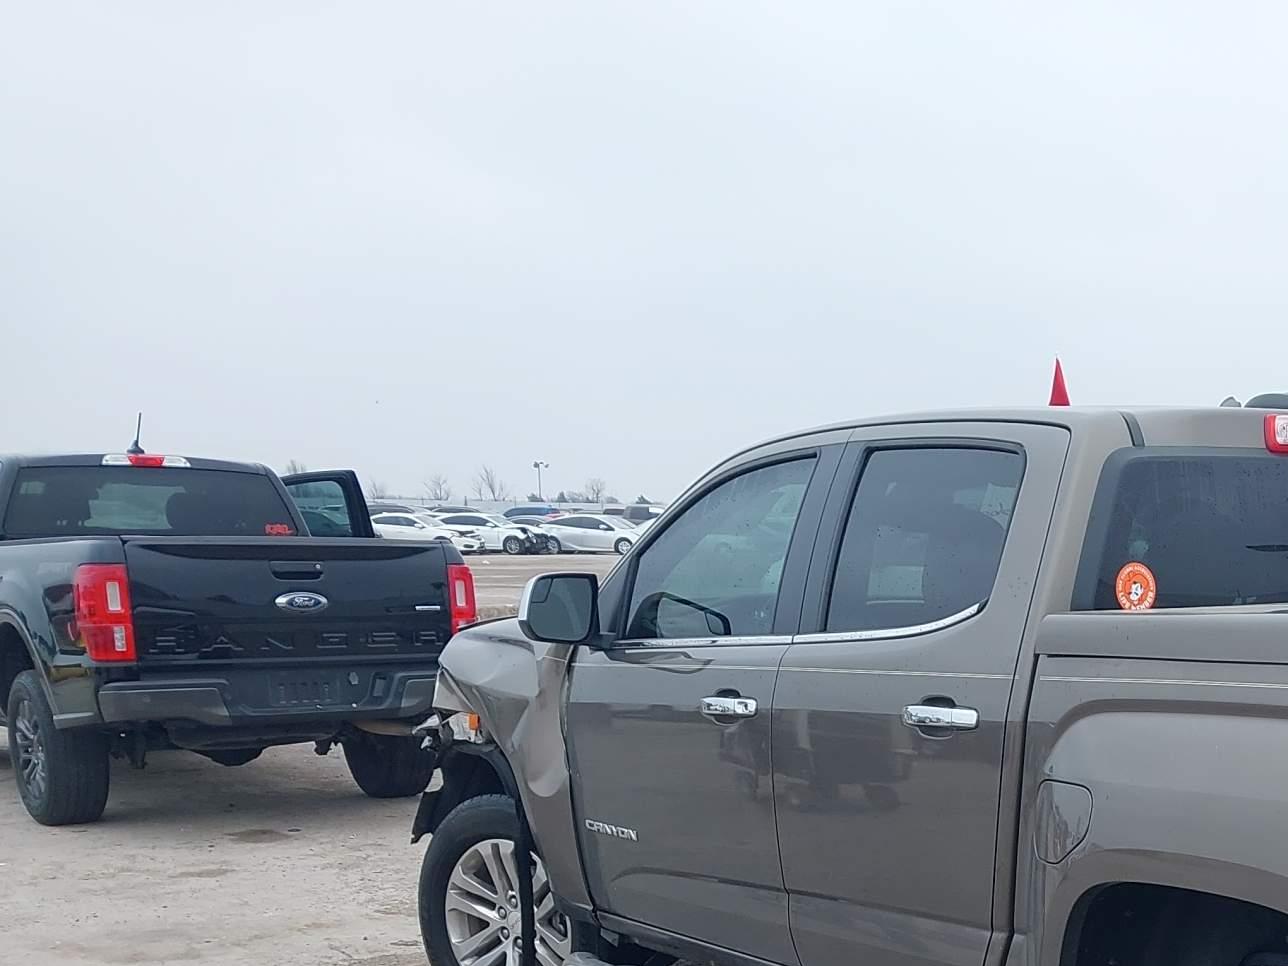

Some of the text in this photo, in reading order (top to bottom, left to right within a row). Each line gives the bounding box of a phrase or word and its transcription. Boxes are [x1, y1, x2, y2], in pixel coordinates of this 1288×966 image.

[292, 596, 315, 607] Ford
[149, 629, 444, 652] RANGER
[585, 819, 638, 842] CANYON
